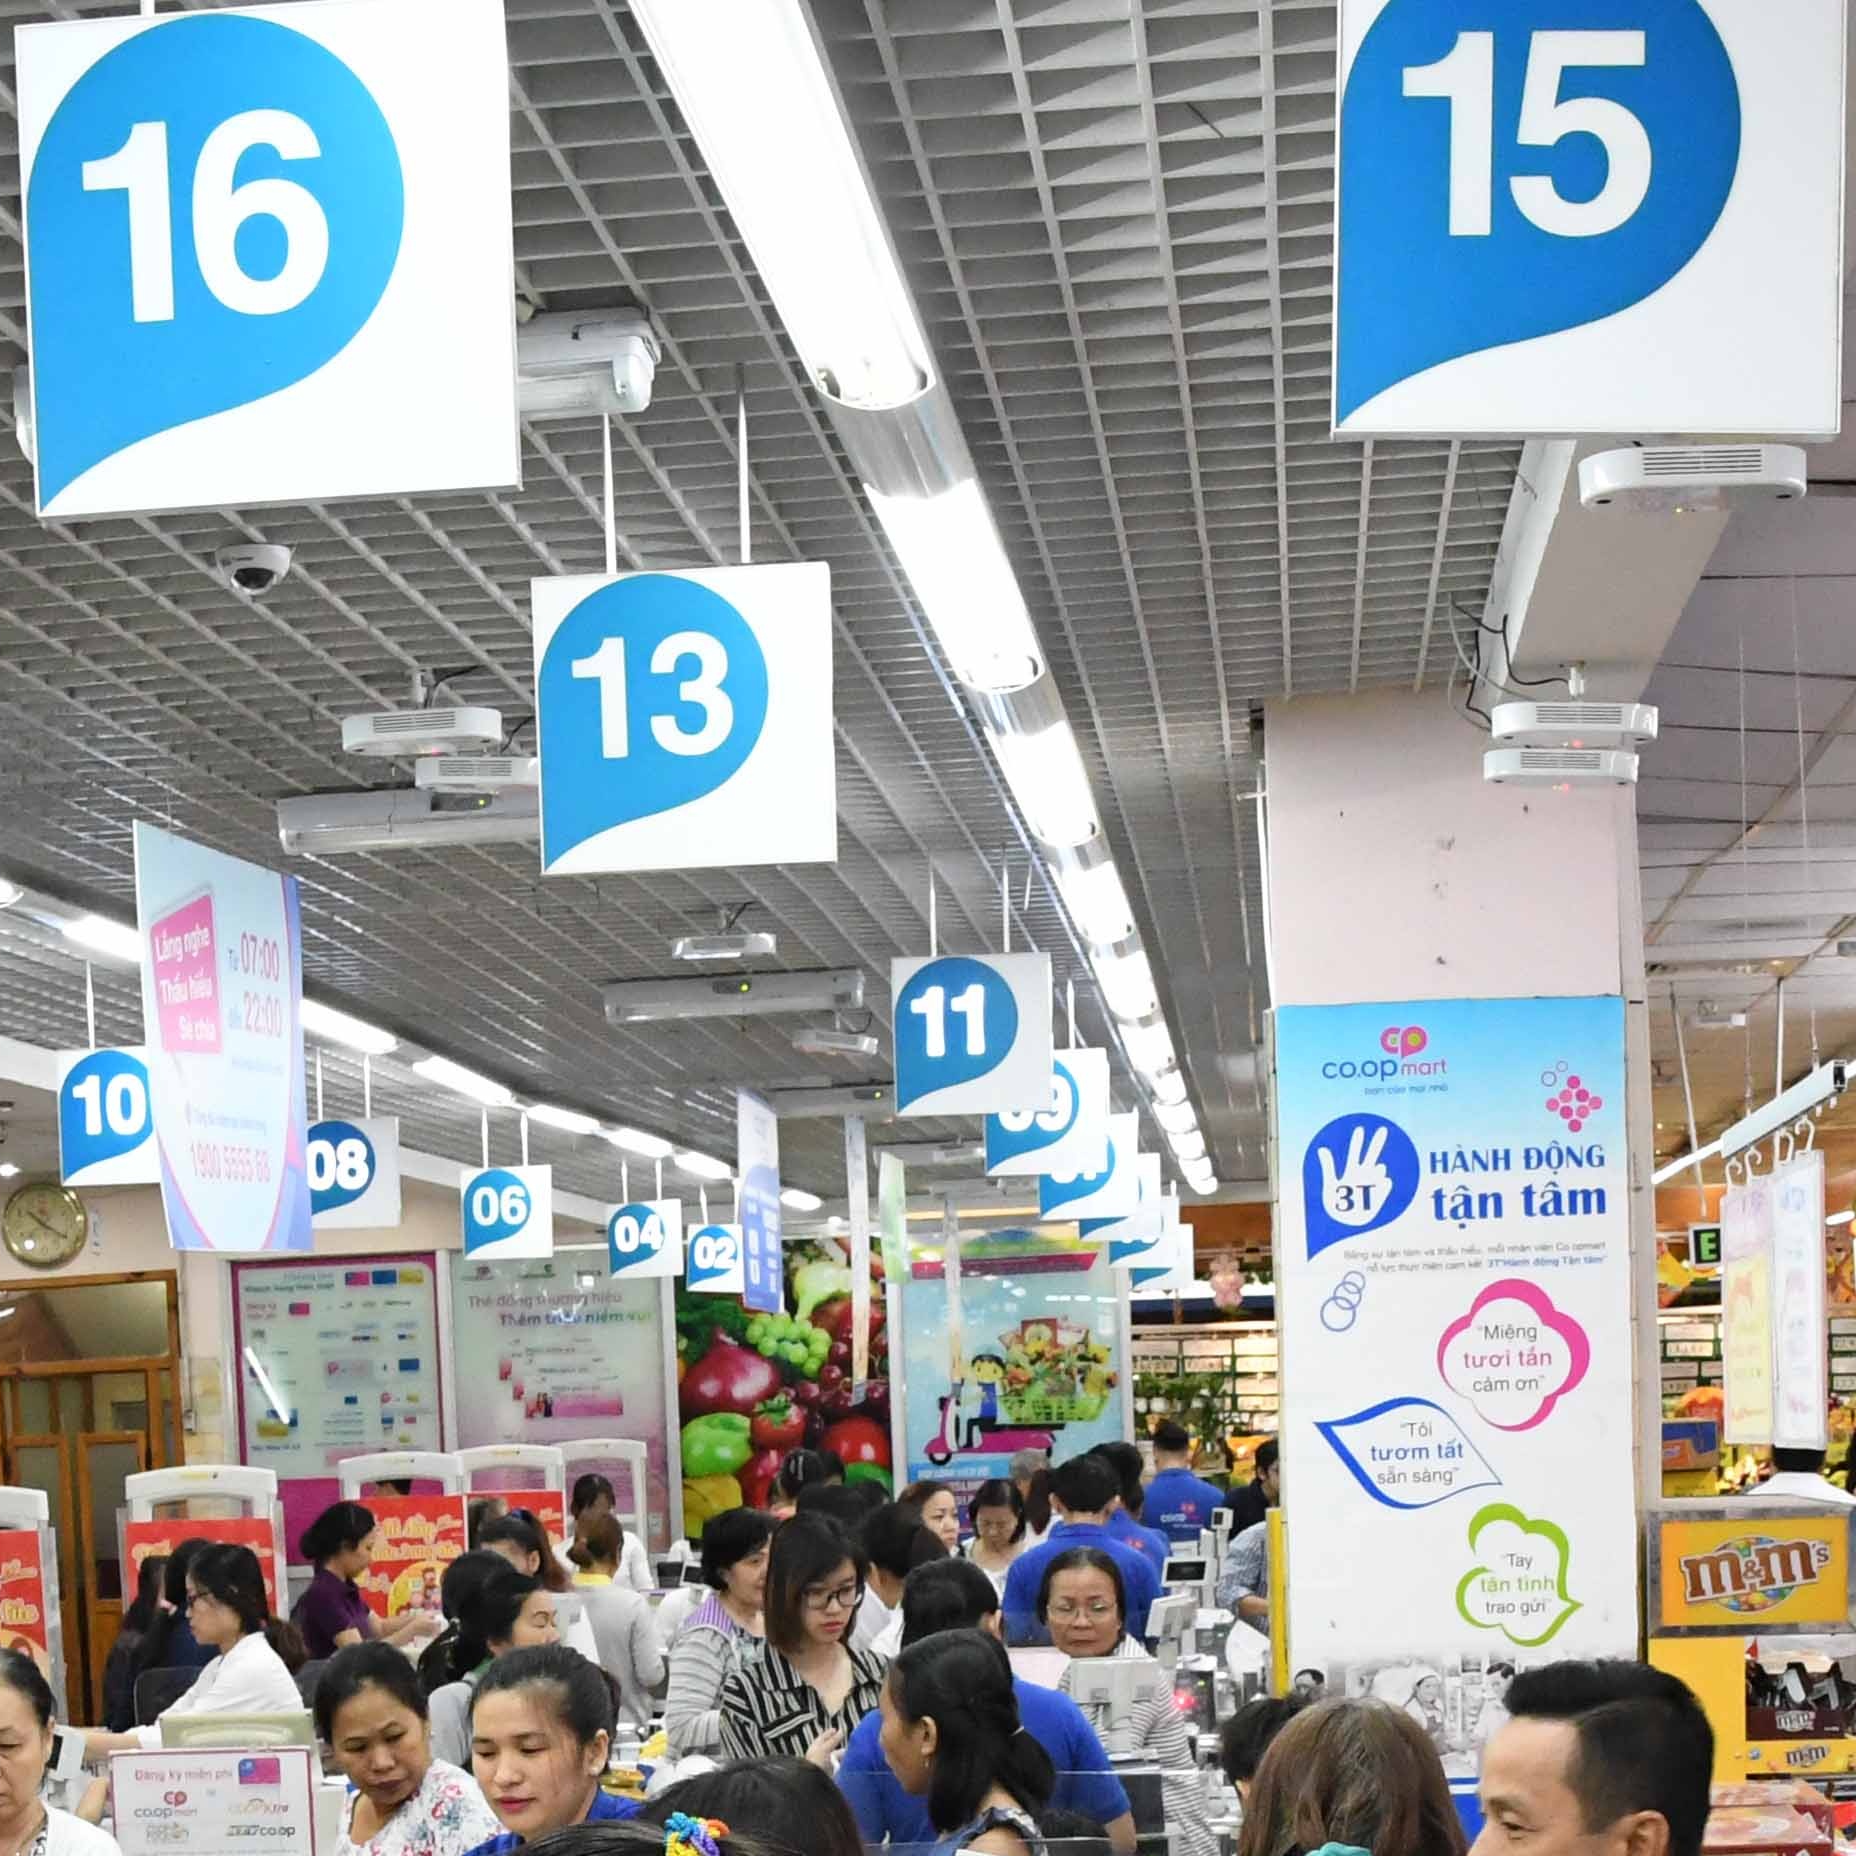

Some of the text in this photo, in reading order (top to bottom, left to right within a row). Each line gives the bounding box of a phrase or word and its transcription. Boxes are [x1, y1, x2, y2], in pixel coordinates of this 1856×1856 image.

[1403, 30, 1652, 237] 15
[82, 109, 329, 323] 16
[572, 630, 734, 760] 13
[154, 922, 211, 965] Lắng nghe
[241, 931, 280, 982] 07:00
[244, 990, 281, 1037] 22:00
[910, 984, 985, 1058] 11
[72, 1073, 146, 1136] 10
[307, 1140, 369, 1191] 08
[1429, 1139, 1606, 1176] HÀNH ĐỘNG
[471, 1187, 527, 1228] 06
[1334, 1184, 1376, 1212] 3T
[1430, 1181, 1607, 1230] tận tâm
[614, 1214, 663, 1252] 04
[694, 1236, 738, 1270] 02
[500, 1307, 626, 1327] Thêm niềm
[1463, 1350, 1511, 1369] tươi
[1370, 1438, 1464, 1462] tươm tất
[1485, 1599, 1516, 1614] trao
